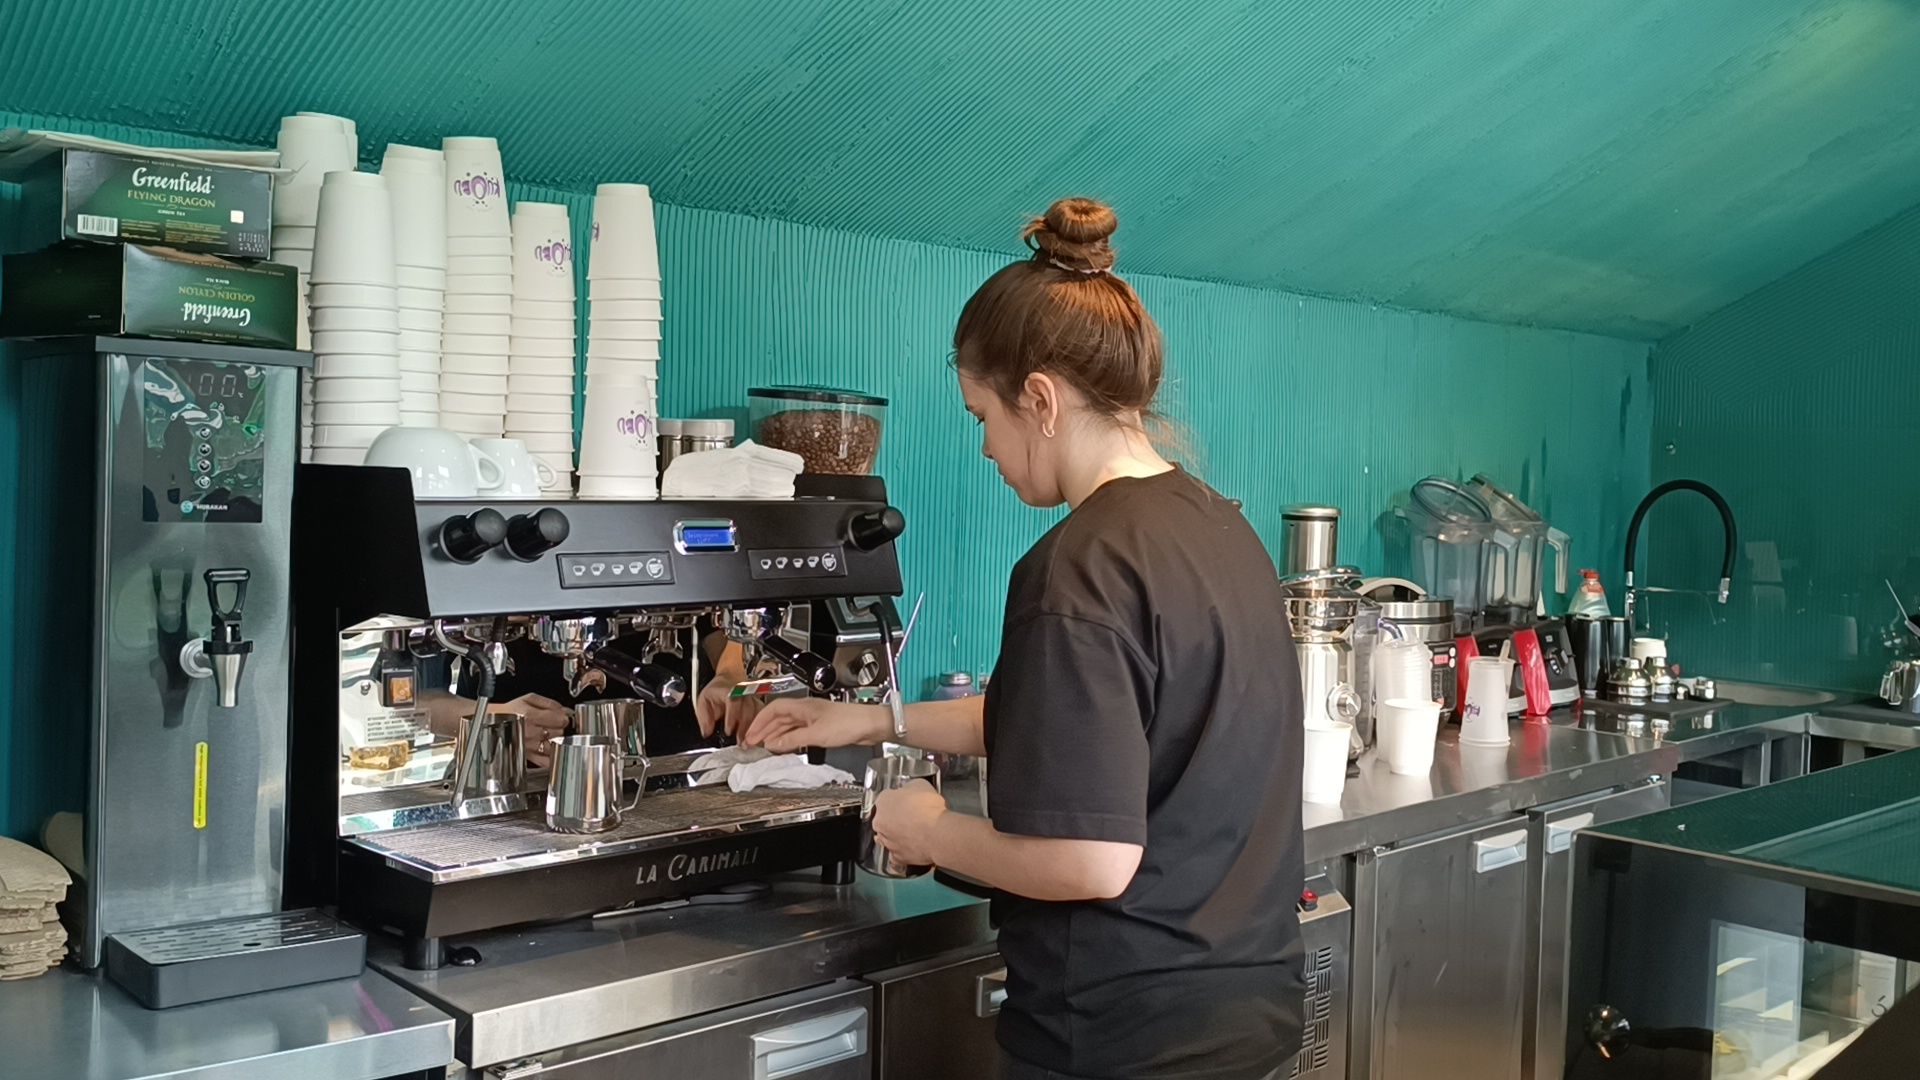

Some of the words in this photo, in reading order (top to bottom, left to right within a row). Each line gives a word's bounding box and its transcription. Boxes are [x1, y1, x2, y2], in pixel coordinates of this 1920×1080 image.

[131, 166, 213, 195] Greenfield
[127, 189, 167, 203] FLYING
[169, 194, 217, 208] DRAGON
[178, 286, 216, 298] CEYLON
[218, 290, 256, 303] GOLDEN
[182, 301, 251, 327] Greenfield
[635, 864, 657, 885] LA
